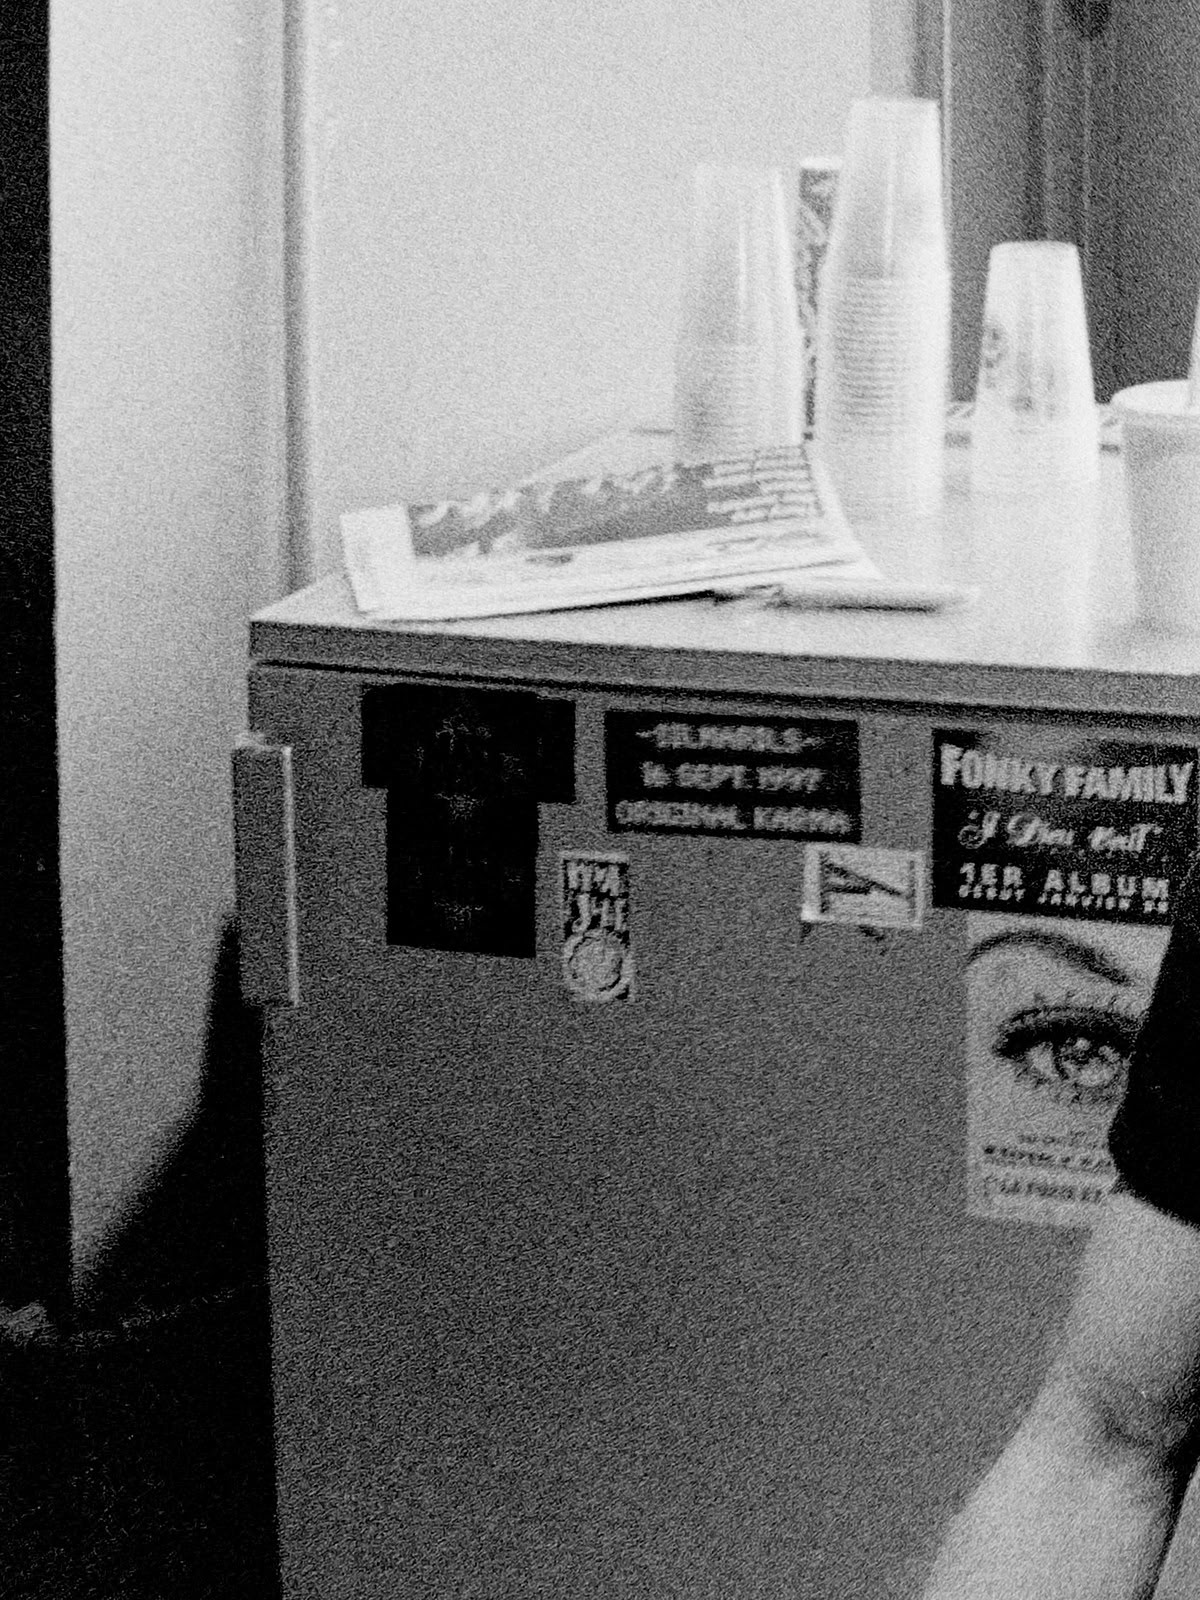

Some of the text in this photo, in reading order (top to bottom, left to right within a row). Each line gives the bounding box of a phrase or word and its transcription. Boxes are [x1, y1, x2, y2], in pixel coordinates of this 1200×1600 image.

[941, 742, 1195, 805] FONKY FAMILY
[959, 861, 1171, 900] 1ER ALBUM
